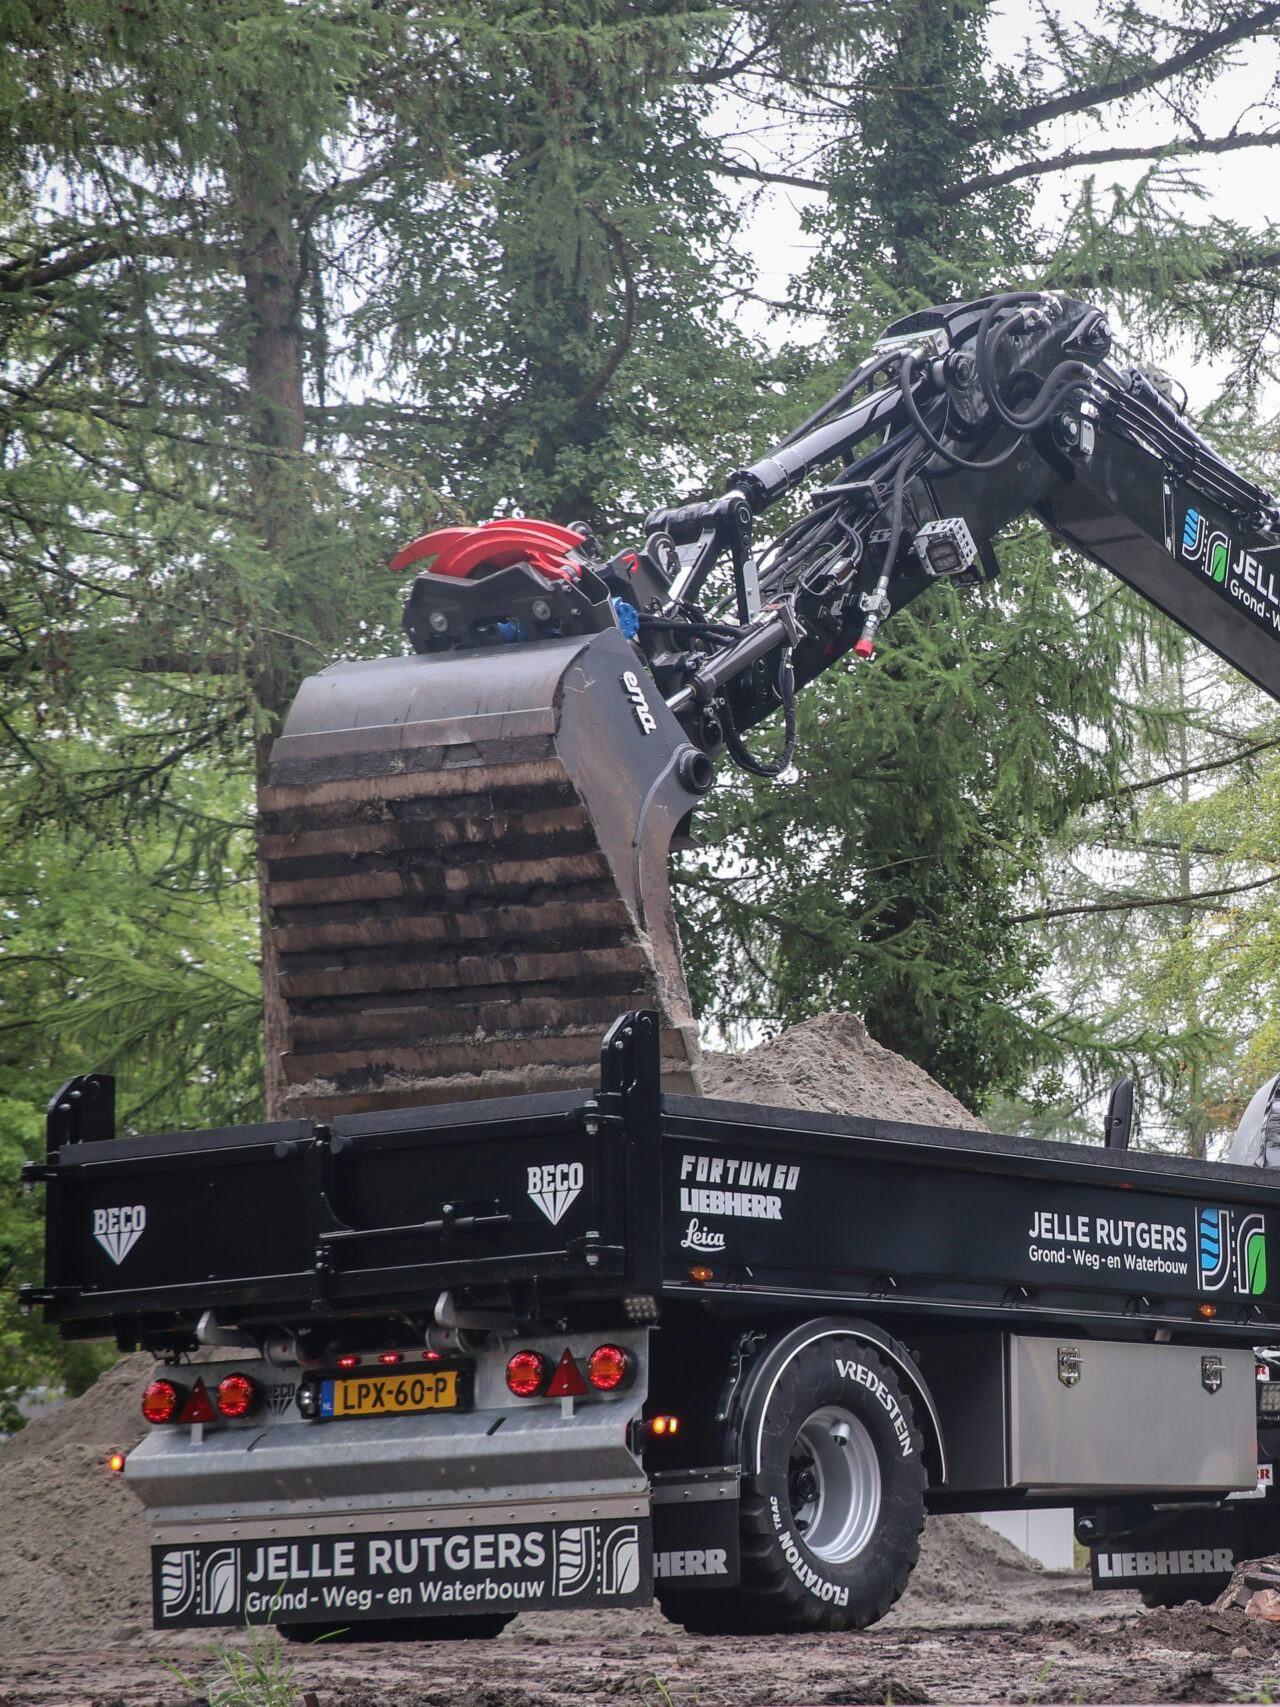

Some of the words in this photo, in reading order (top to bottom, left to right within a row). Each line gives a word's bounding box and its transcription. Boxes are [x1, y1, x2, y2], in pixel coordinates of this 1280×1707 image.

[623, 671, 657, 734] ema
[527, 1162, 584, 1194] BECO
[680, 1155, 772, 1188] FORTUM
[93, 1205, 147, 1235] BECO
[680, 1187, 783, 1220] LIEBHERR
[680, 1218, 726, 1252] Leica
[1029, 1212, 1090, 1242] JELLE
[1096, 1218, 1188, 1252] RUTGERS
[1124, 1253, 1188, 1274] Waterbouw
[343, 1378, 447, 1411] LPX-60-P
[835, 1359, 913, 1457] VREDESTEIN
[770, 1495, 782, 1530] TRAC
[246, 1542, 355, 1581] JELLE
[369, 1531, 546, 1575] RUTGERS
[779, 1531, 849, 1606] FLOTATION
[1098, 1548, 1234, 1578] LIEBHERR
[419, 1578, 545, 1603] Waterbouw
